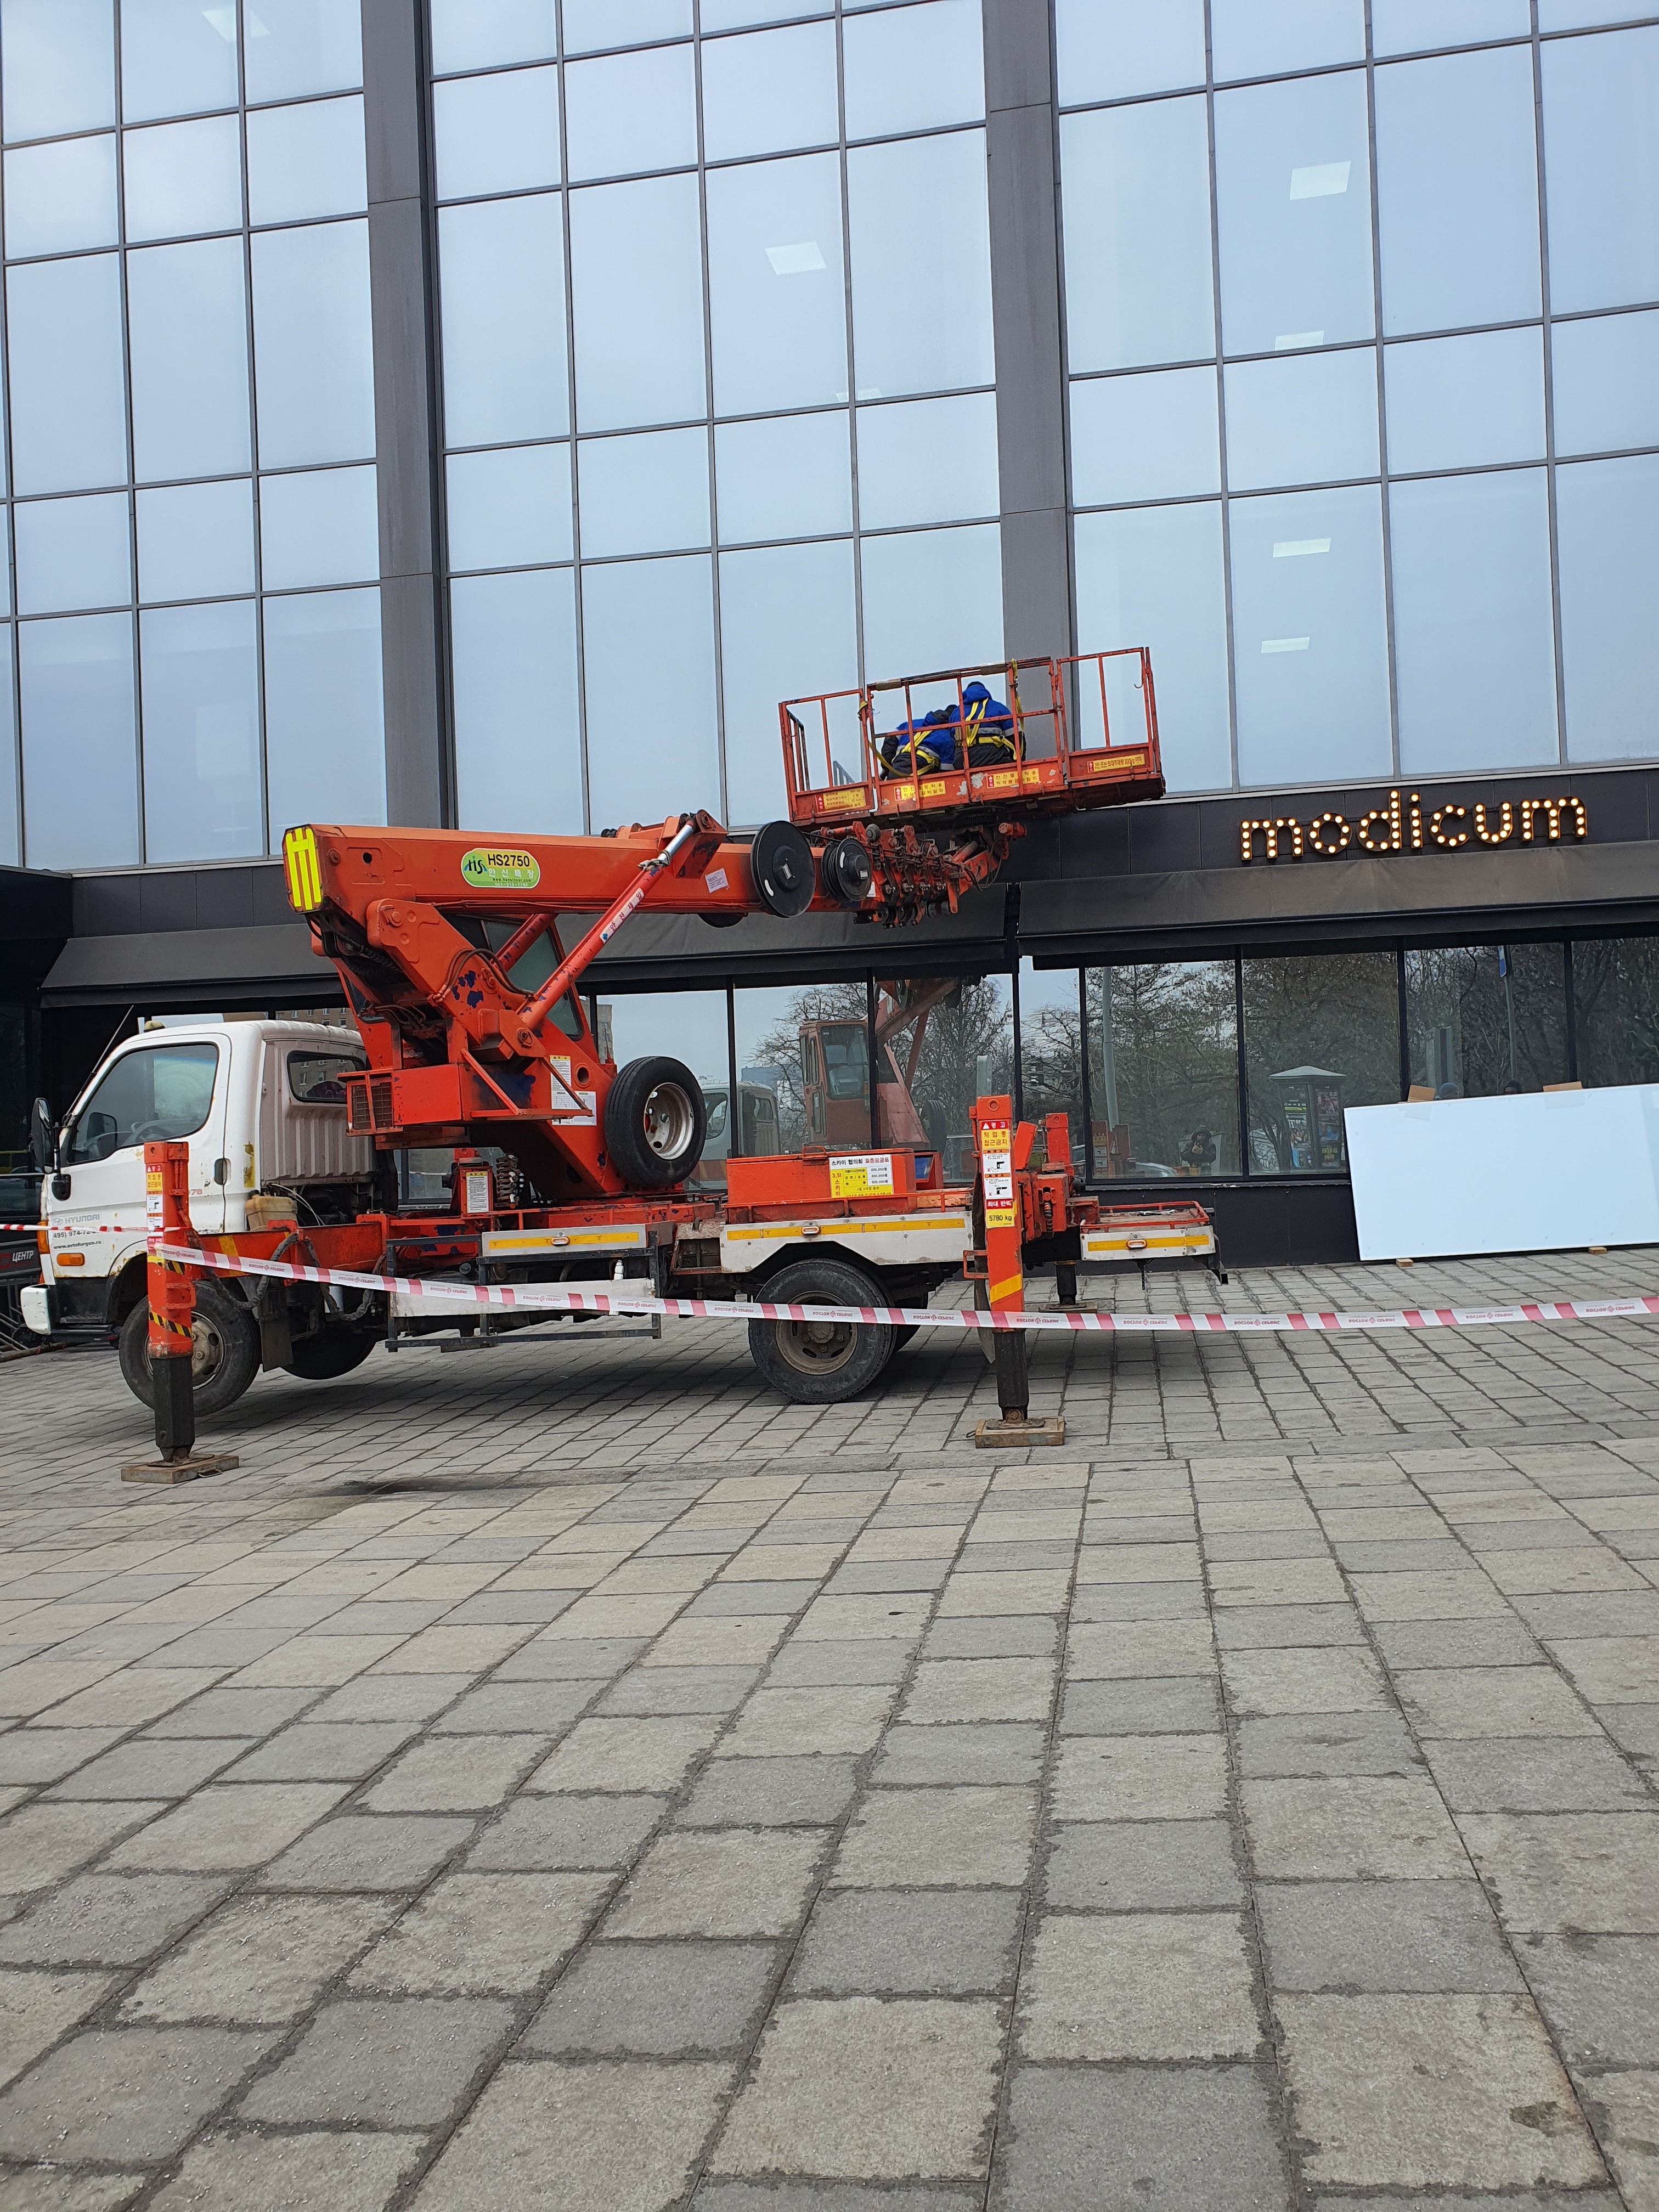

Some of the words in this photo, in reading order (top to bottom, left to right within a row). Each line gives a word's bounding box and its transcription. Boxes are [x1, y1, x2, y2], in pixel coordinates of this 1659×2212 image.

[1240, 790, 1588, 861] modicum
[487, 853, 530, 867] HS2750
[65, 1214, 100, 1224] HYUNDAI
[12, 1250, 34, 1263] ЦЕНТР
